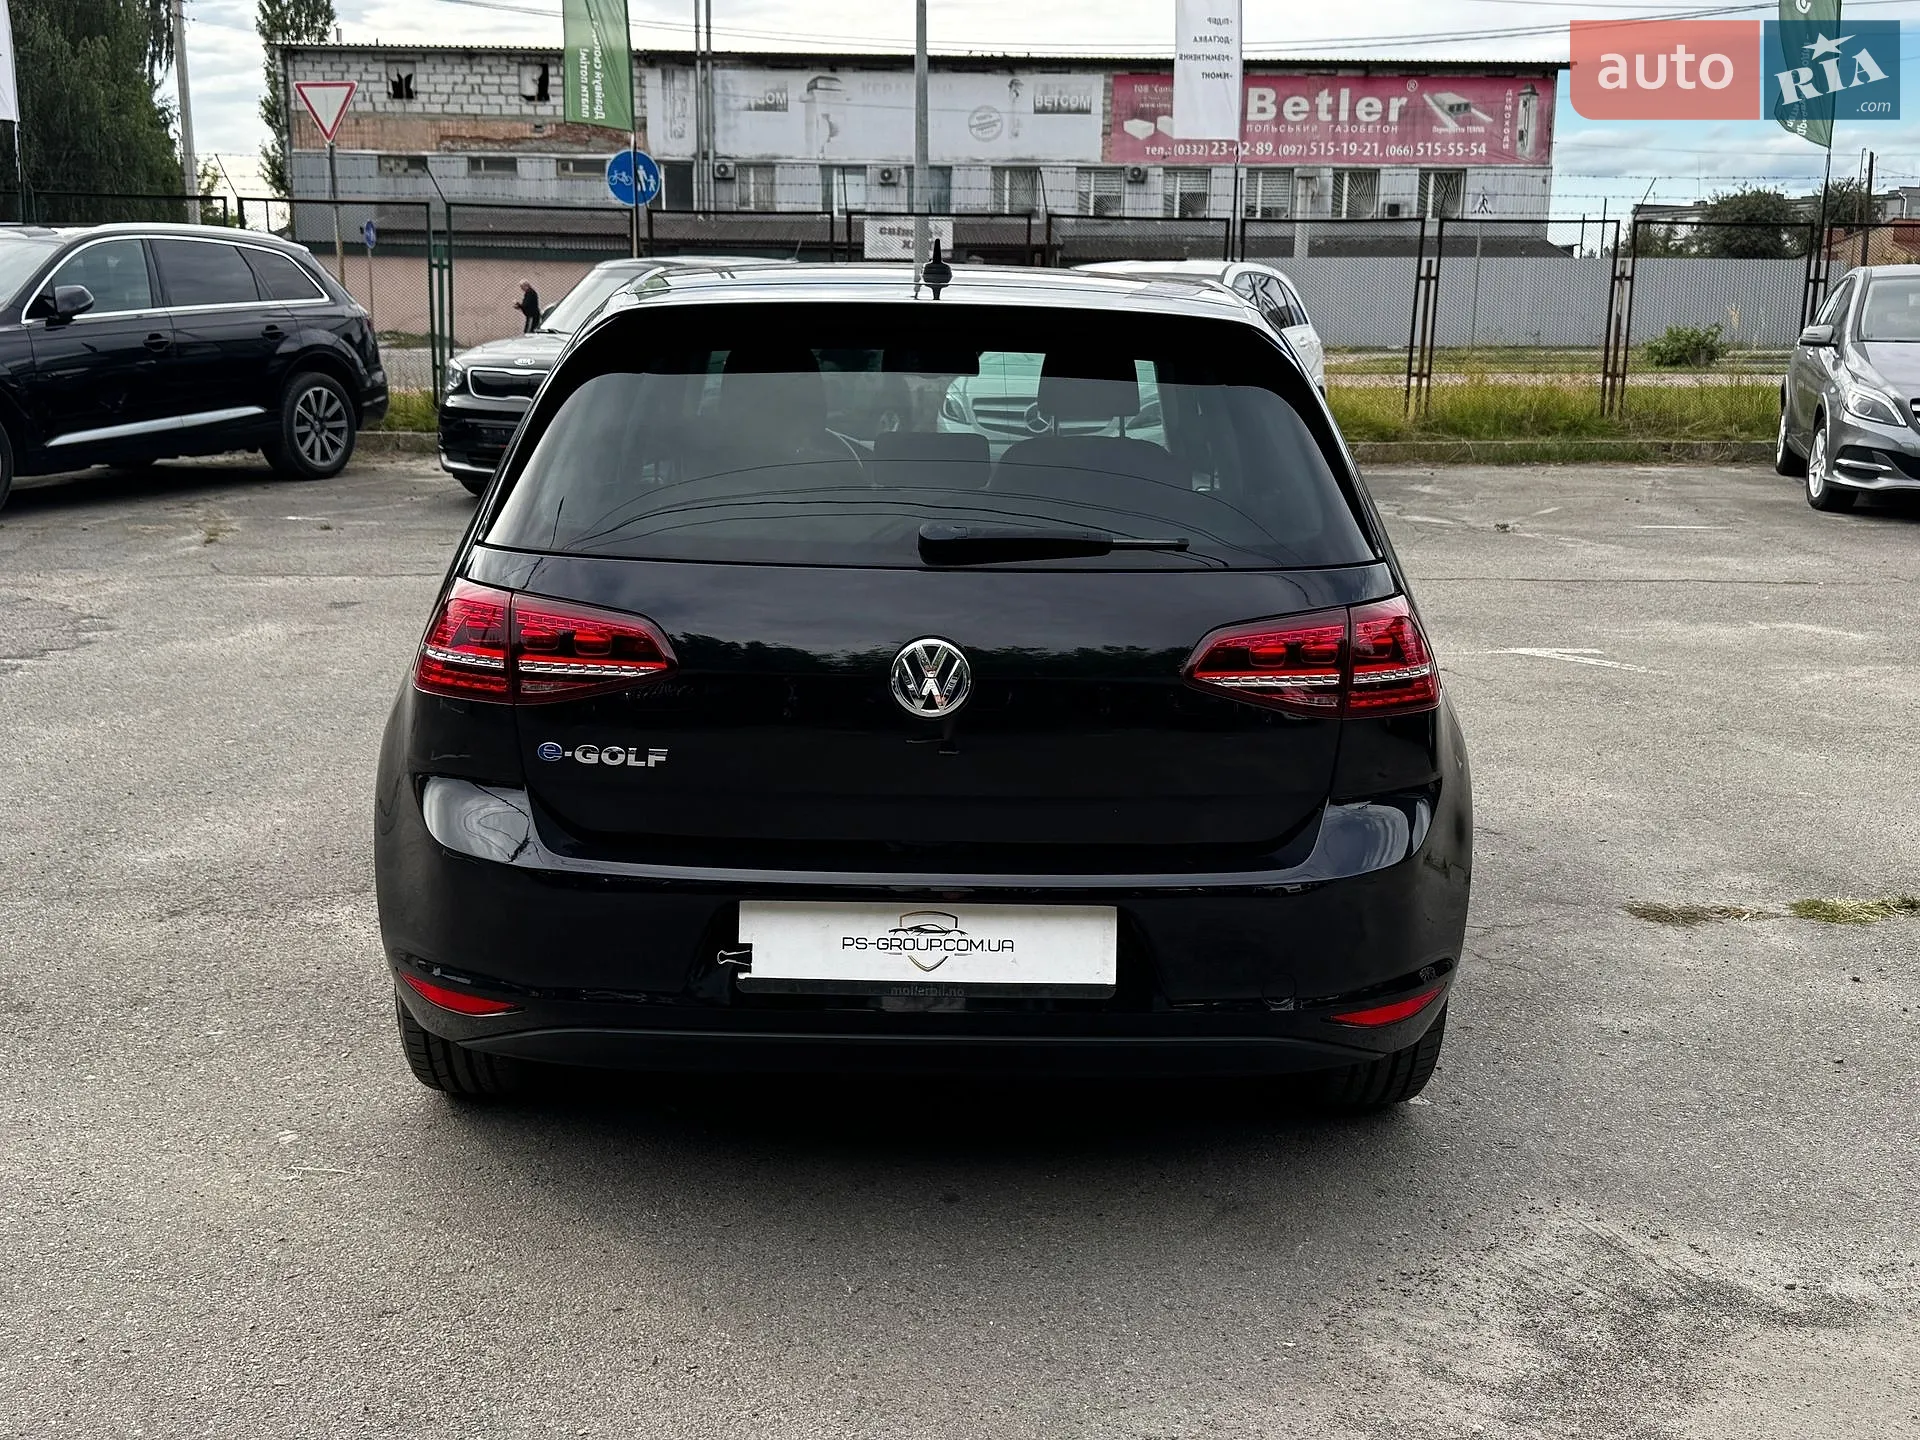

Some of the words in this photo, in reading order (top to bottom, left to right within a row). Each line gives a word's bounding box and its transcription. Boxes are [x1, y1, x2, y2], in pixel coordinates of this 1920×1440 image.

[1246, 87, 1408, 122] Betler
[1246, 124, 1319, 134] ПОЛЬСЬКИЙ
[1328, 124, 1399, 134] ГАЗОБЕТОН
[1173, 143, 1209, 157] (0332)
[1278, 144, 1307, 157] (097)
[1310, 142, 1384, 157] 515-19-21,
[1385, 144, 1414, 157] (066)
[1416, 142, 1487, 157] 515-55-54
[537, 741, 669, 768] e-GOLF
[842, 937, 1015, 953] PS-GROUP.COM.UA
